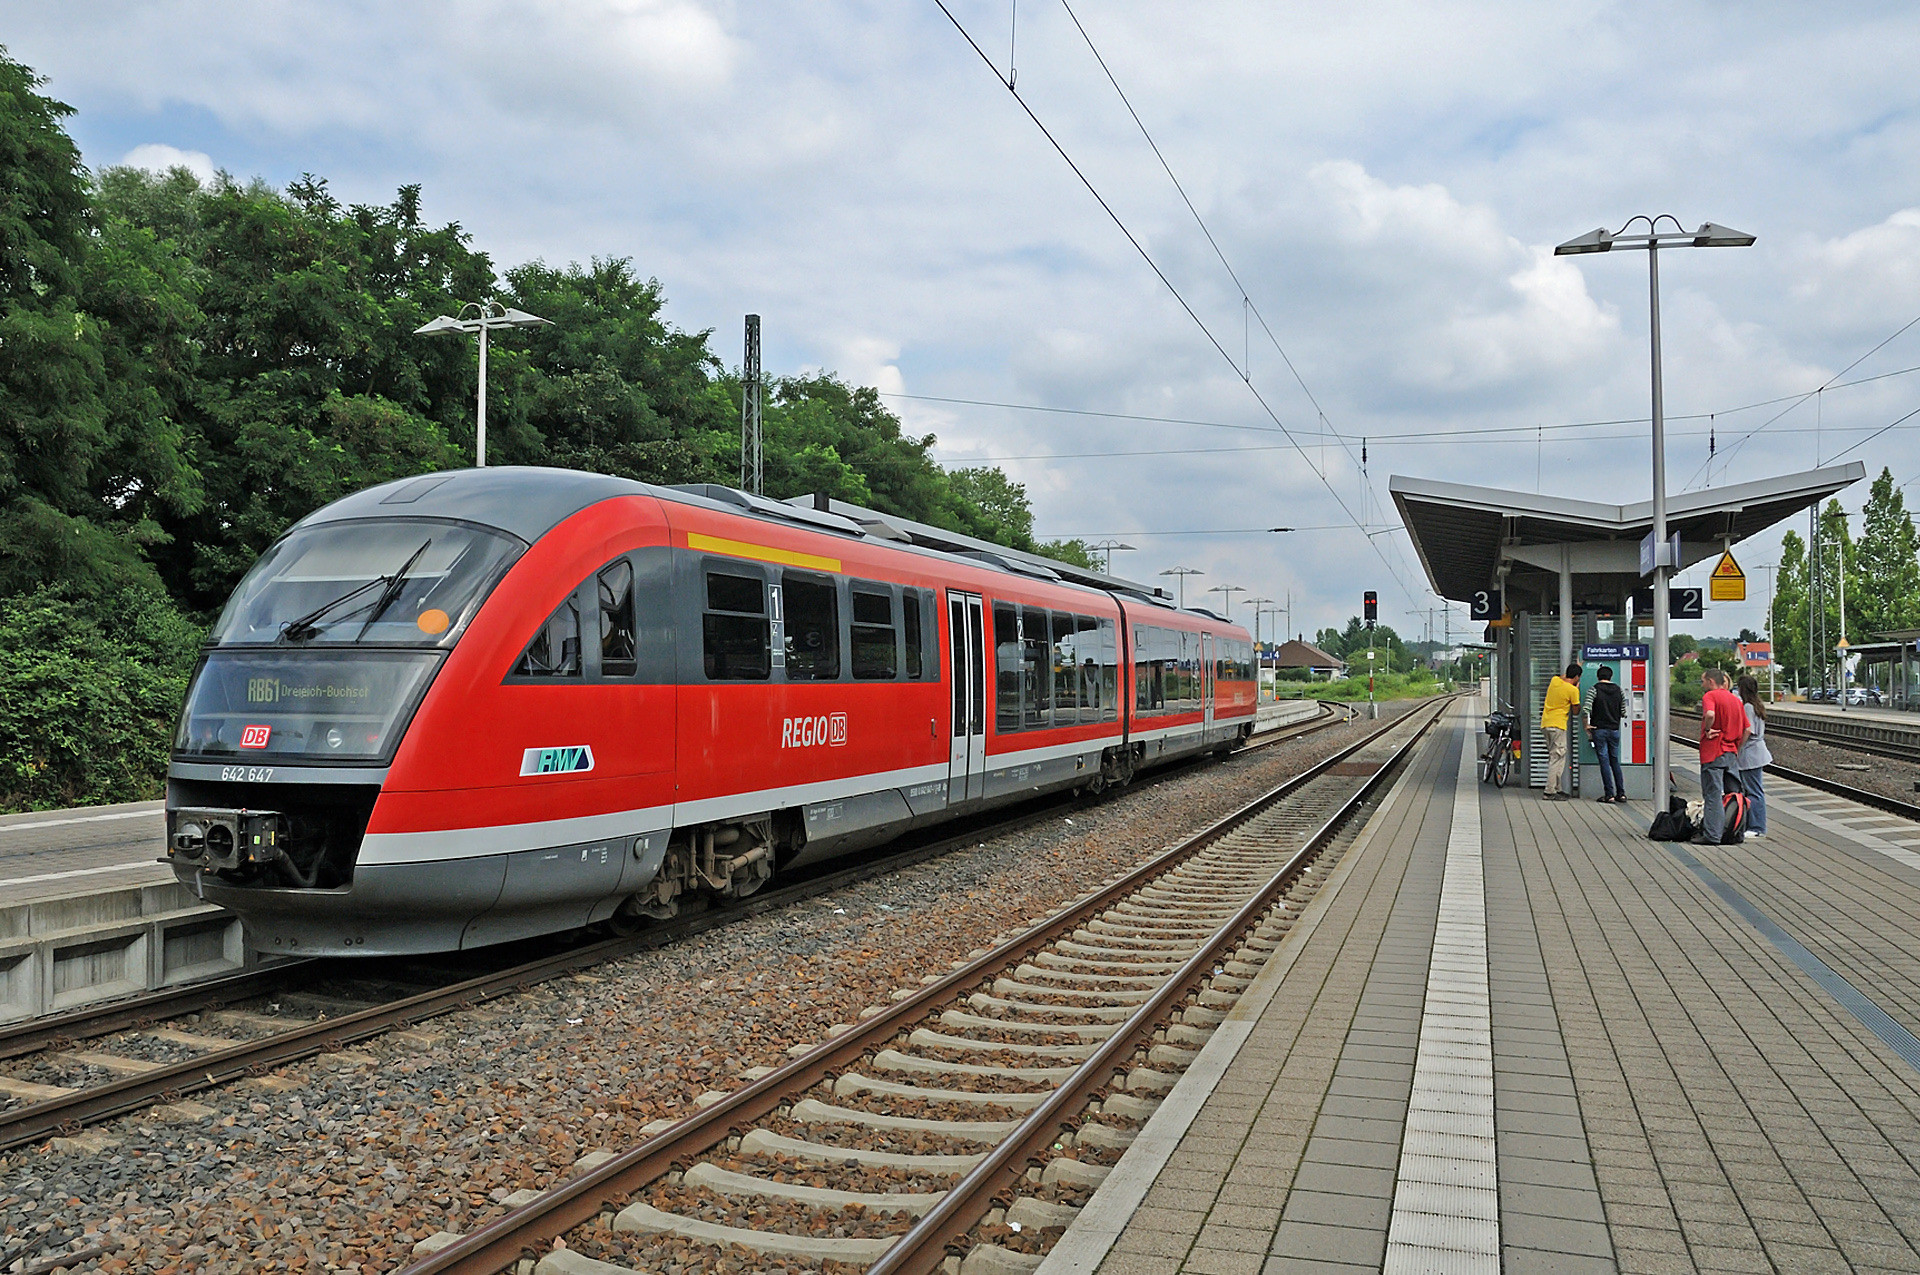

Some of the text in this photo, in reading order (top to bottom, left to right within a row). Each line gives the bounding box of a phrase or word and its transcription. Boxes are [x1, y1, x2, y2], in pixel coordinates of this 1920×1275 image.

[771, 588, 779, 619] 1
[1474, 591, 1490, 614] 3
[1682, 589, 1699, 612] 2
[1274, 650, 1280, 659] 4
[248, 679, 280, 702] RB61
[243, 728, 269, 745] DB
[781, 715, 846, 748] REGIO DB
[221, 767, 274, 782] 642 647
